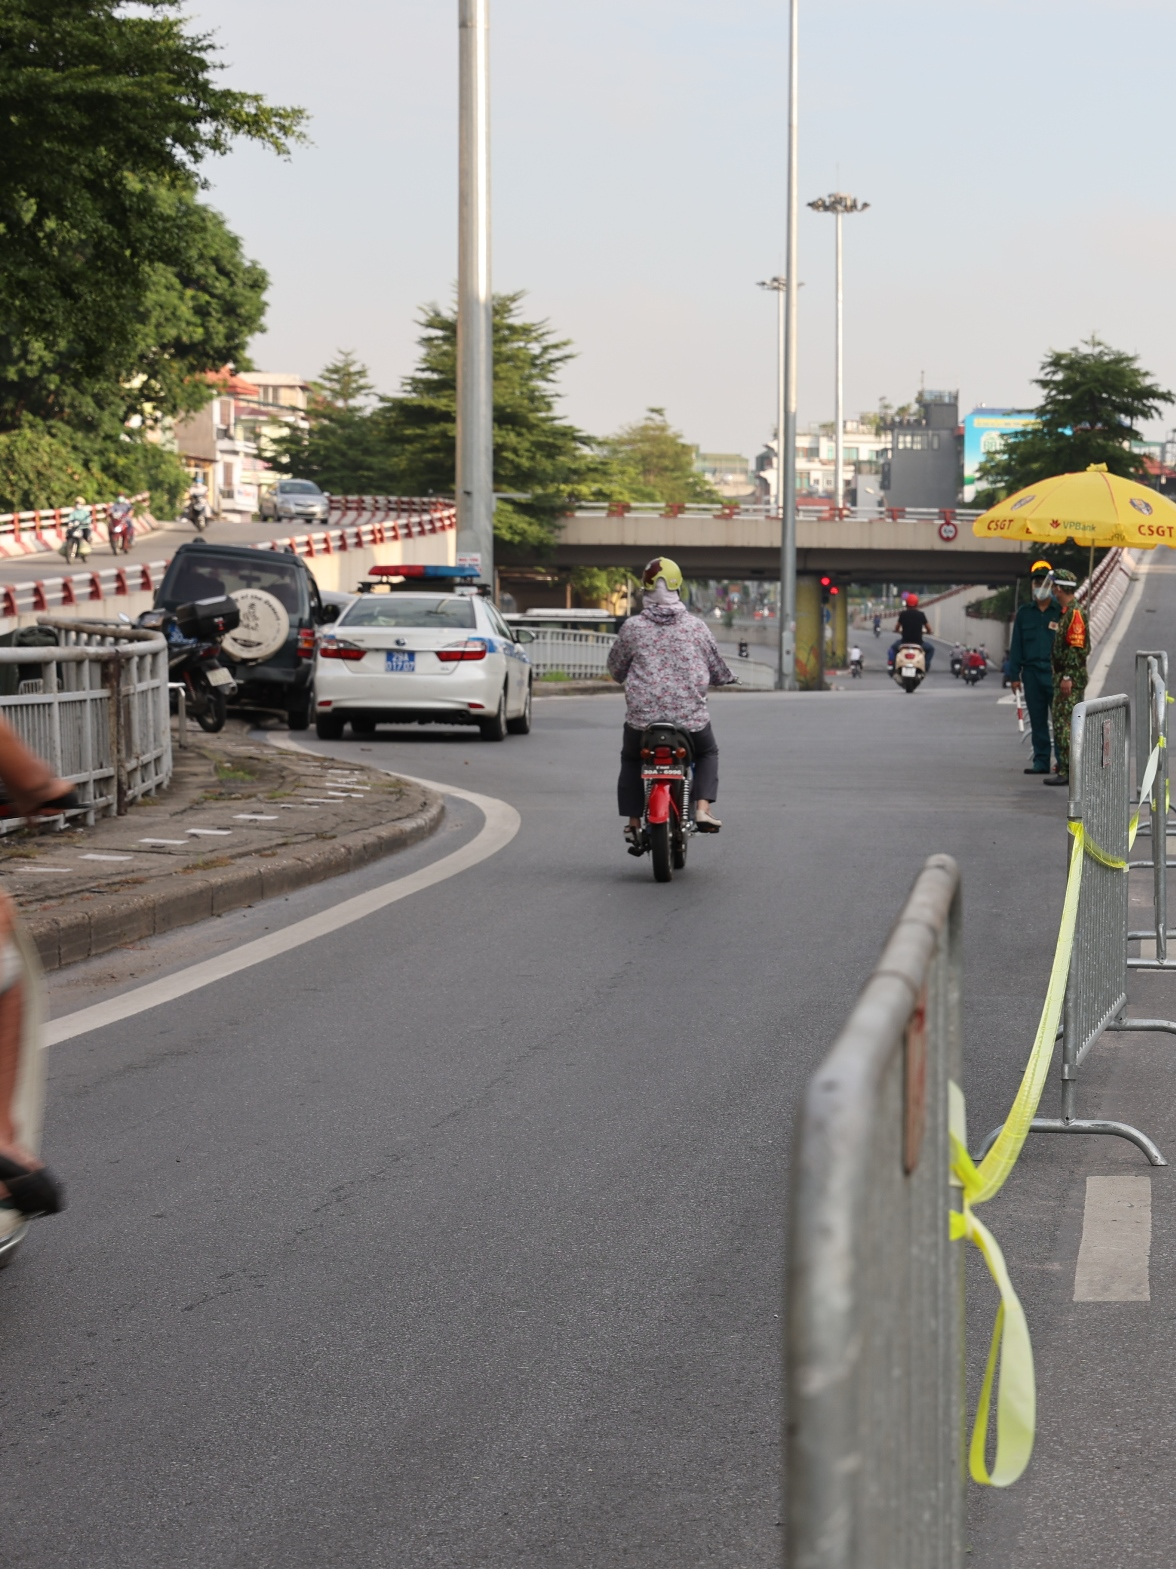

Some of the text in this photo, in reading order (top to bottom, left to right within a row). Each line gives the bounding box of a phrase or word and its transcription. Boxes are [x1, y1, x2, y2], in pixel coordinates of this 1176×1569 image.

[986, 519, 1014, 531] CSGT
[1063, 520, 1096, 532] VPBank
[1138, 524, 1174, 538] CSGT
